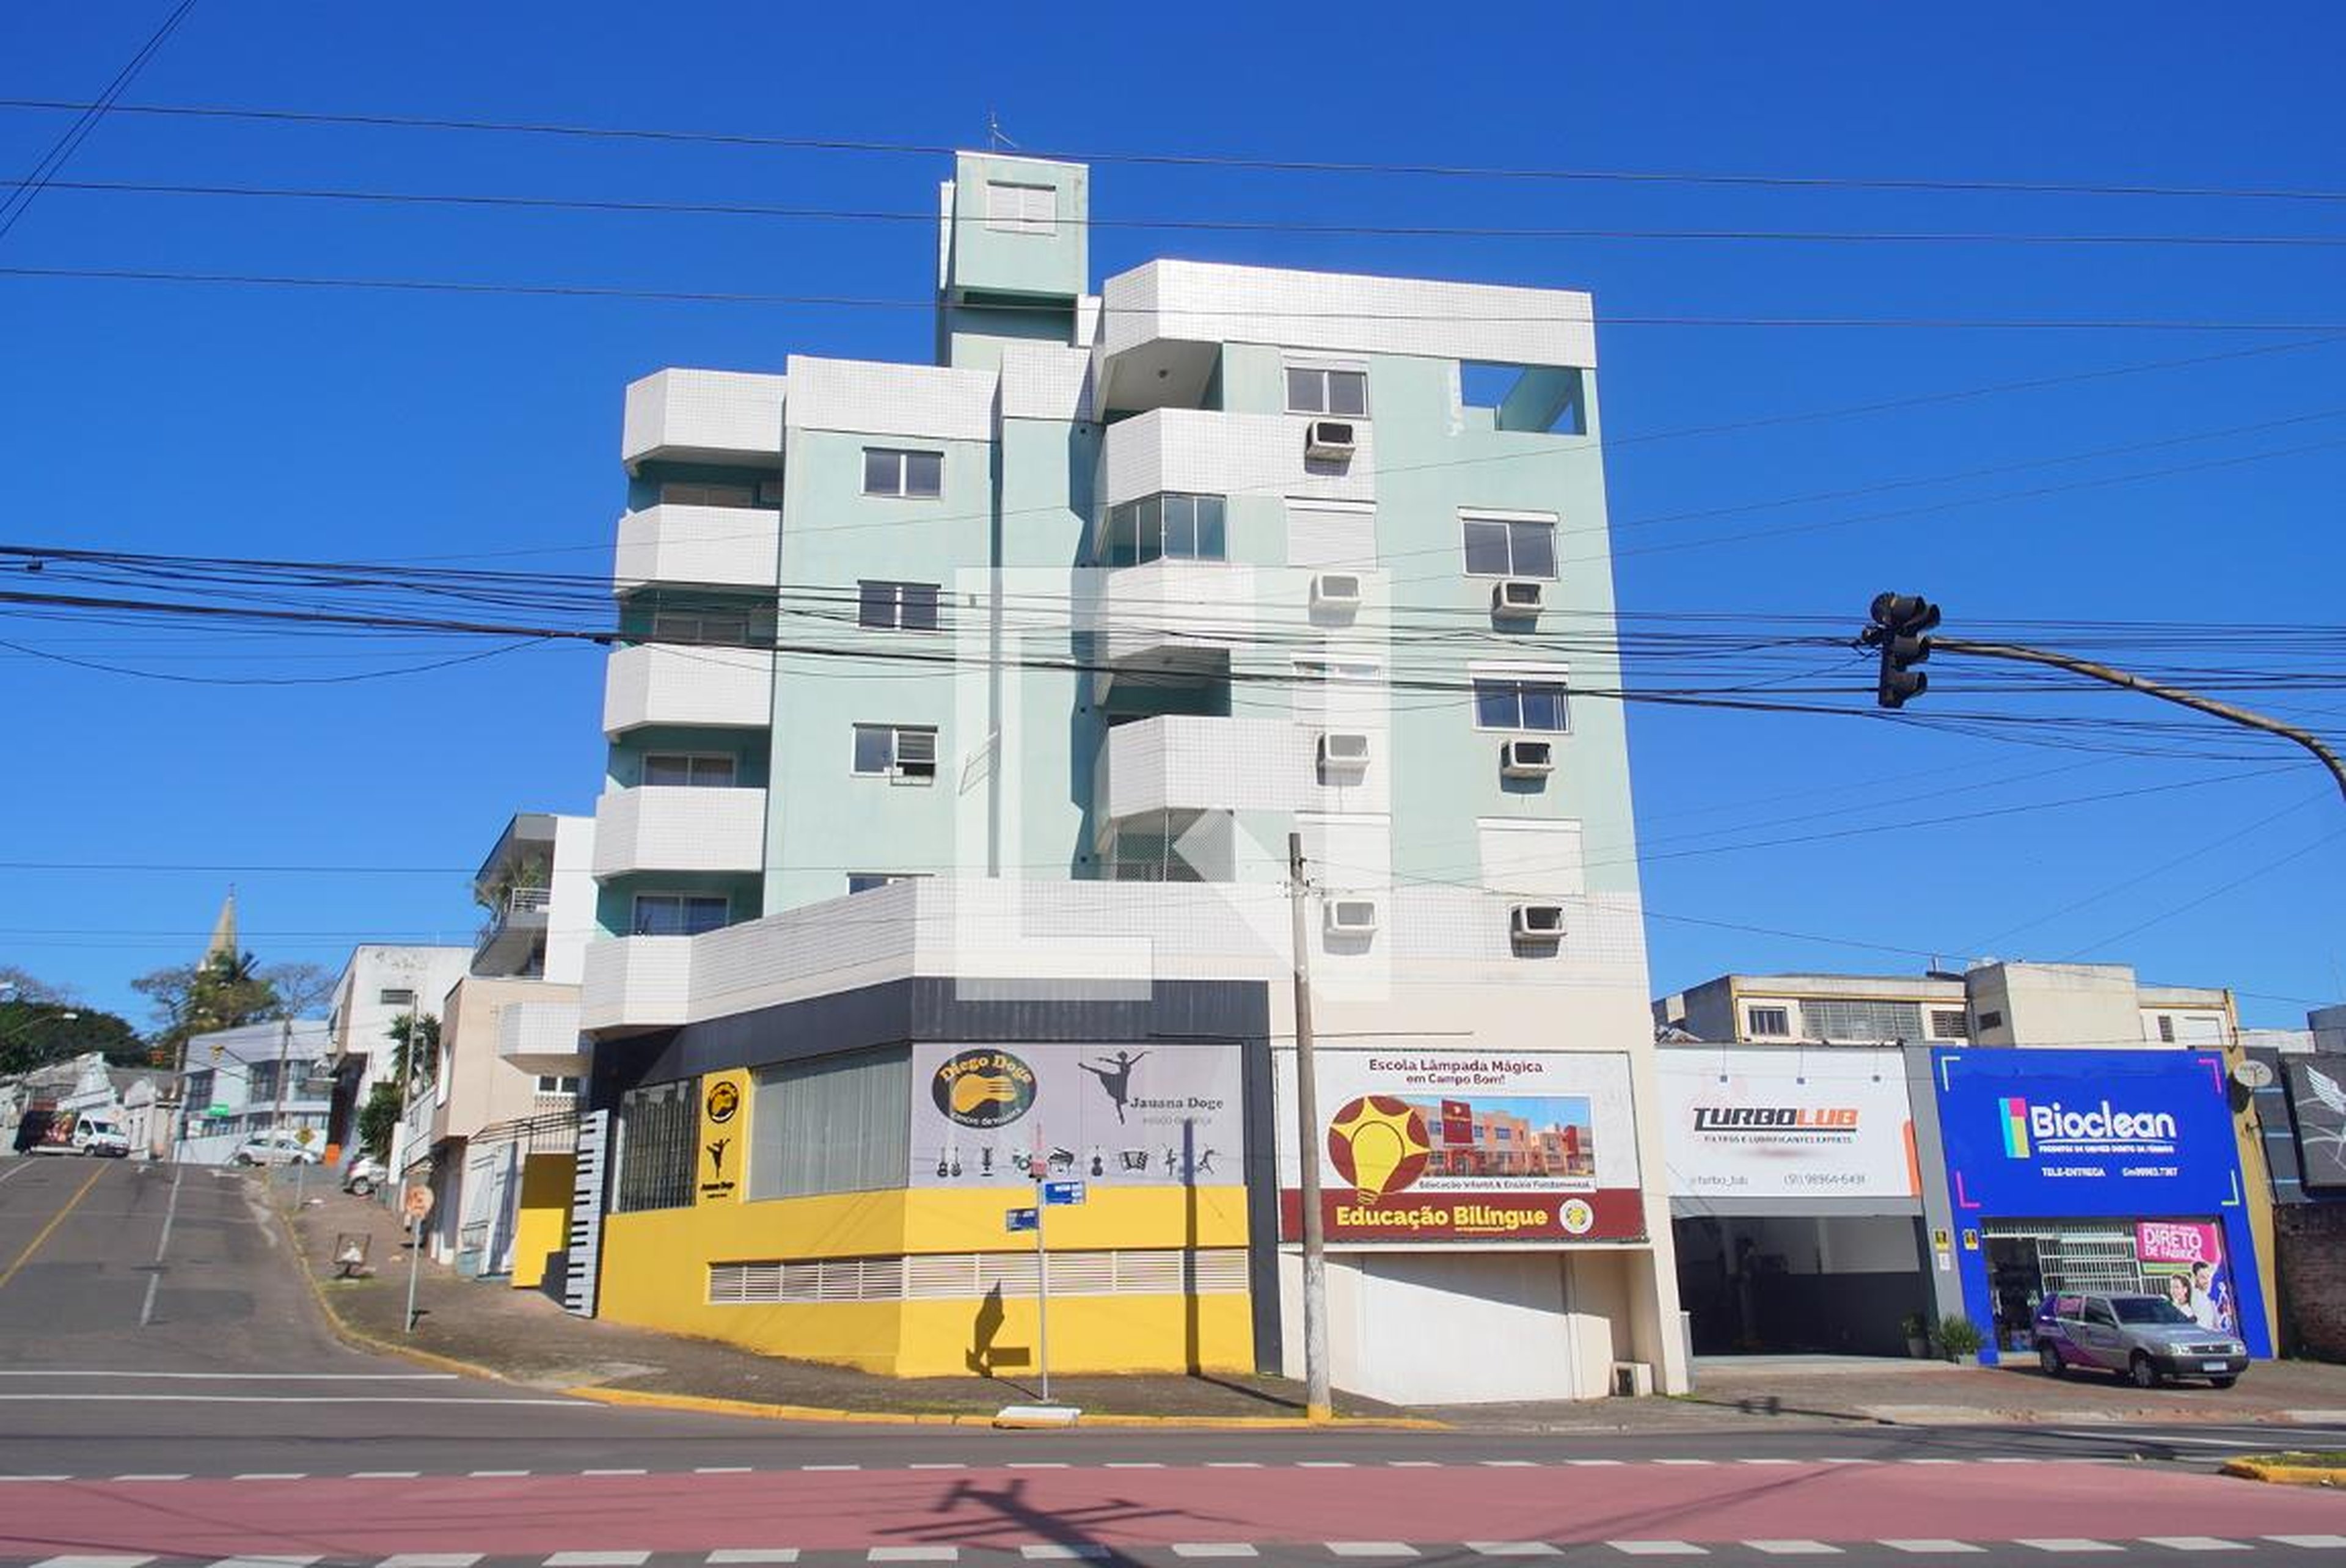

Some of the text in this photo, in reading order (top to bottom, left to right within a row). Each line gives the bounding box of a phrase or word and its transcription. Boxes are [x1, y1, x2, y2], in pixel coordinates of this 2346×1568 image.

[939, 1054, 1032, 1083] Diego Doge
[1369, 1059, 1544, 1075] Escola Lâmpada Mágica
[1406, 1075, 1426, 1084] em
[1428, 1073, 1471, 1086] Campo
[1188, 1097, 1224, 1110] Doge
[1693, 1108, 1858, 1132] TURBOLUB
[2030, 1101, 2177, 1139] Bioclean
[2042, 1167, 2106, 1177] TELE-ENTREGA
[1336, 1205, 1549, 1230] Educação Bilíngue
[2144, 1228, 2202, 1250] DIRETO
